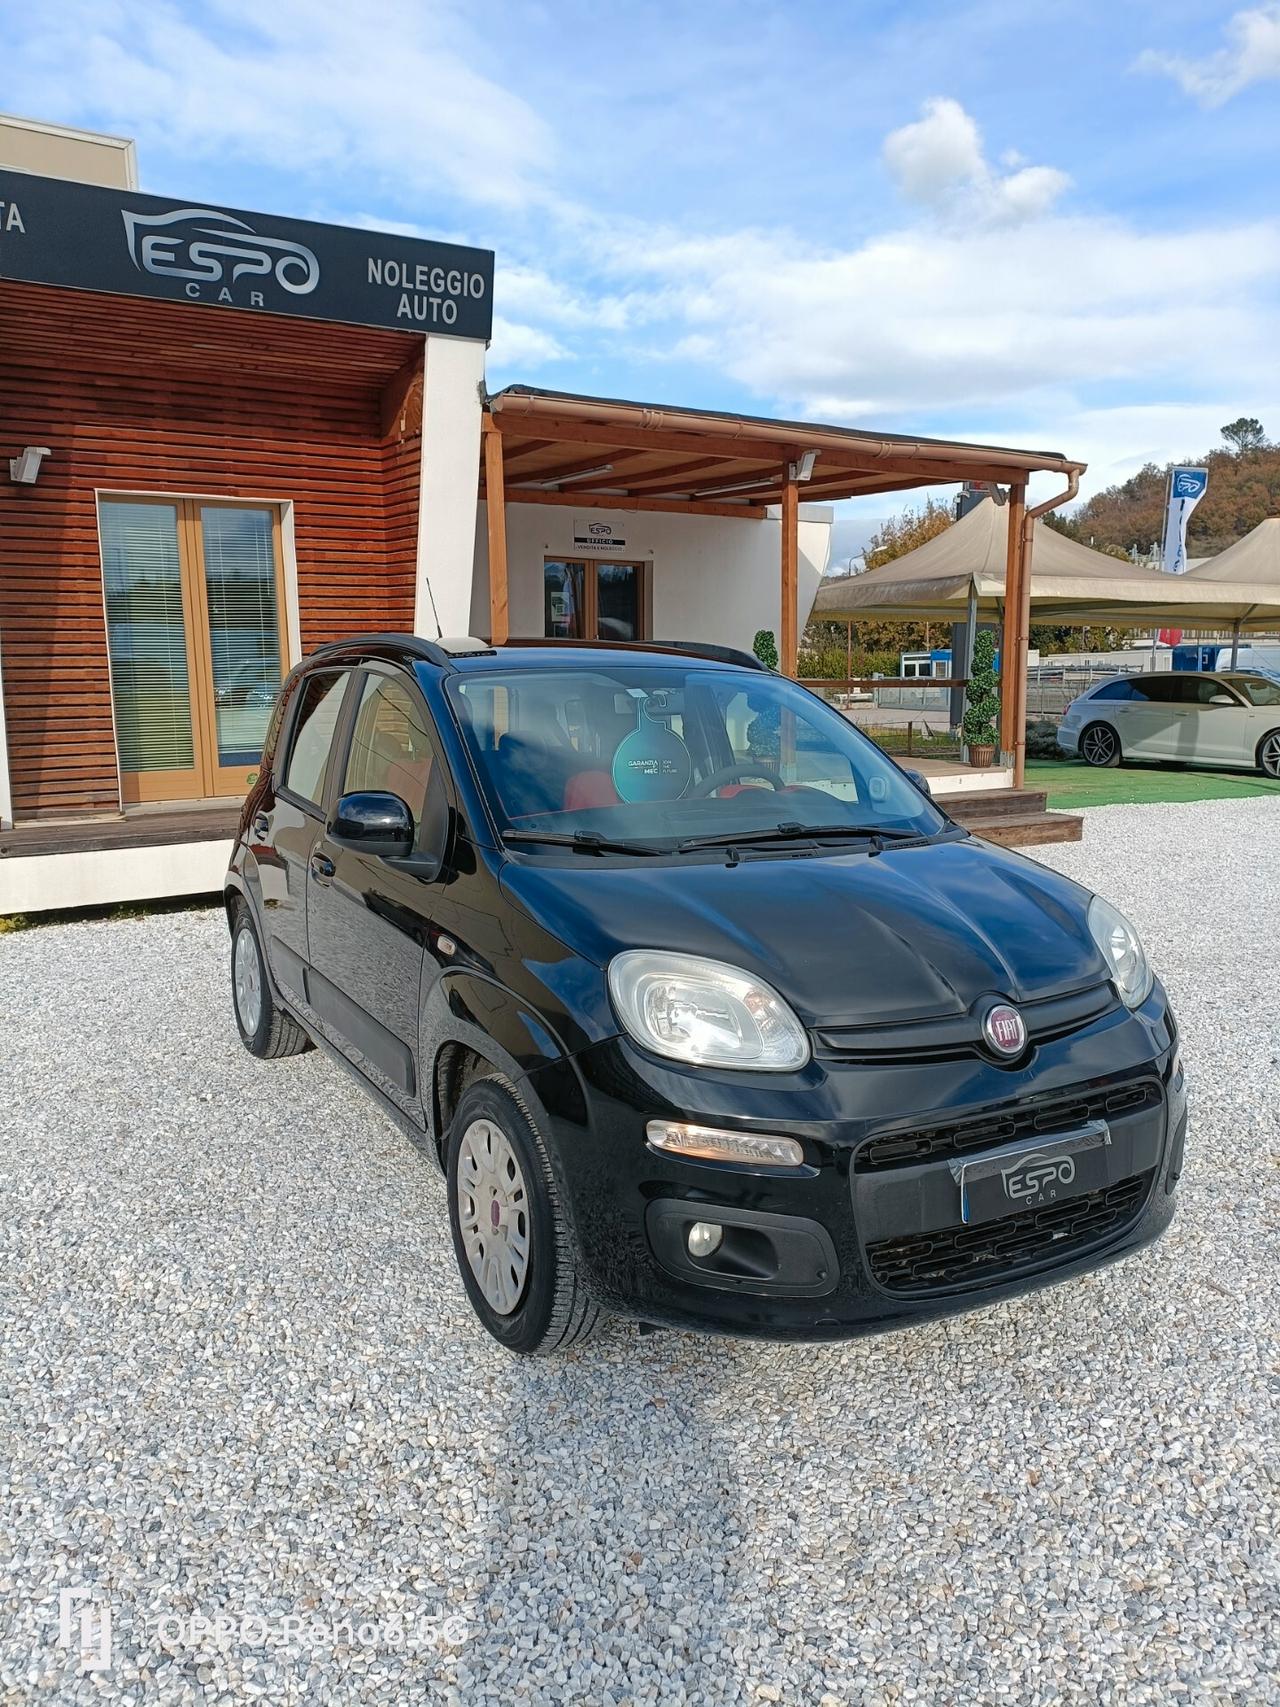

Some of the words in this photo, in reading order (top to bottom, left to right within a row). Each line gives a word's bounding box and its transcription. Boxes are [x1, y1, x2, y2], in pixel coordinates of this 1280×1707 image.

[141, 227, 320, 295] ESPO
[367, 257, 485, 299] NOLEGGIO
[185, 282, 265, 307] CAR
[396, 293, 458, 325] AUTO
[590, 525, 612, 535] ESPO
[995, 1018, 1018, 1042] FIAT
[1008, 1155, 1076, 1199] ESPO
[1025, 1189, 1056, 1205] CAR
